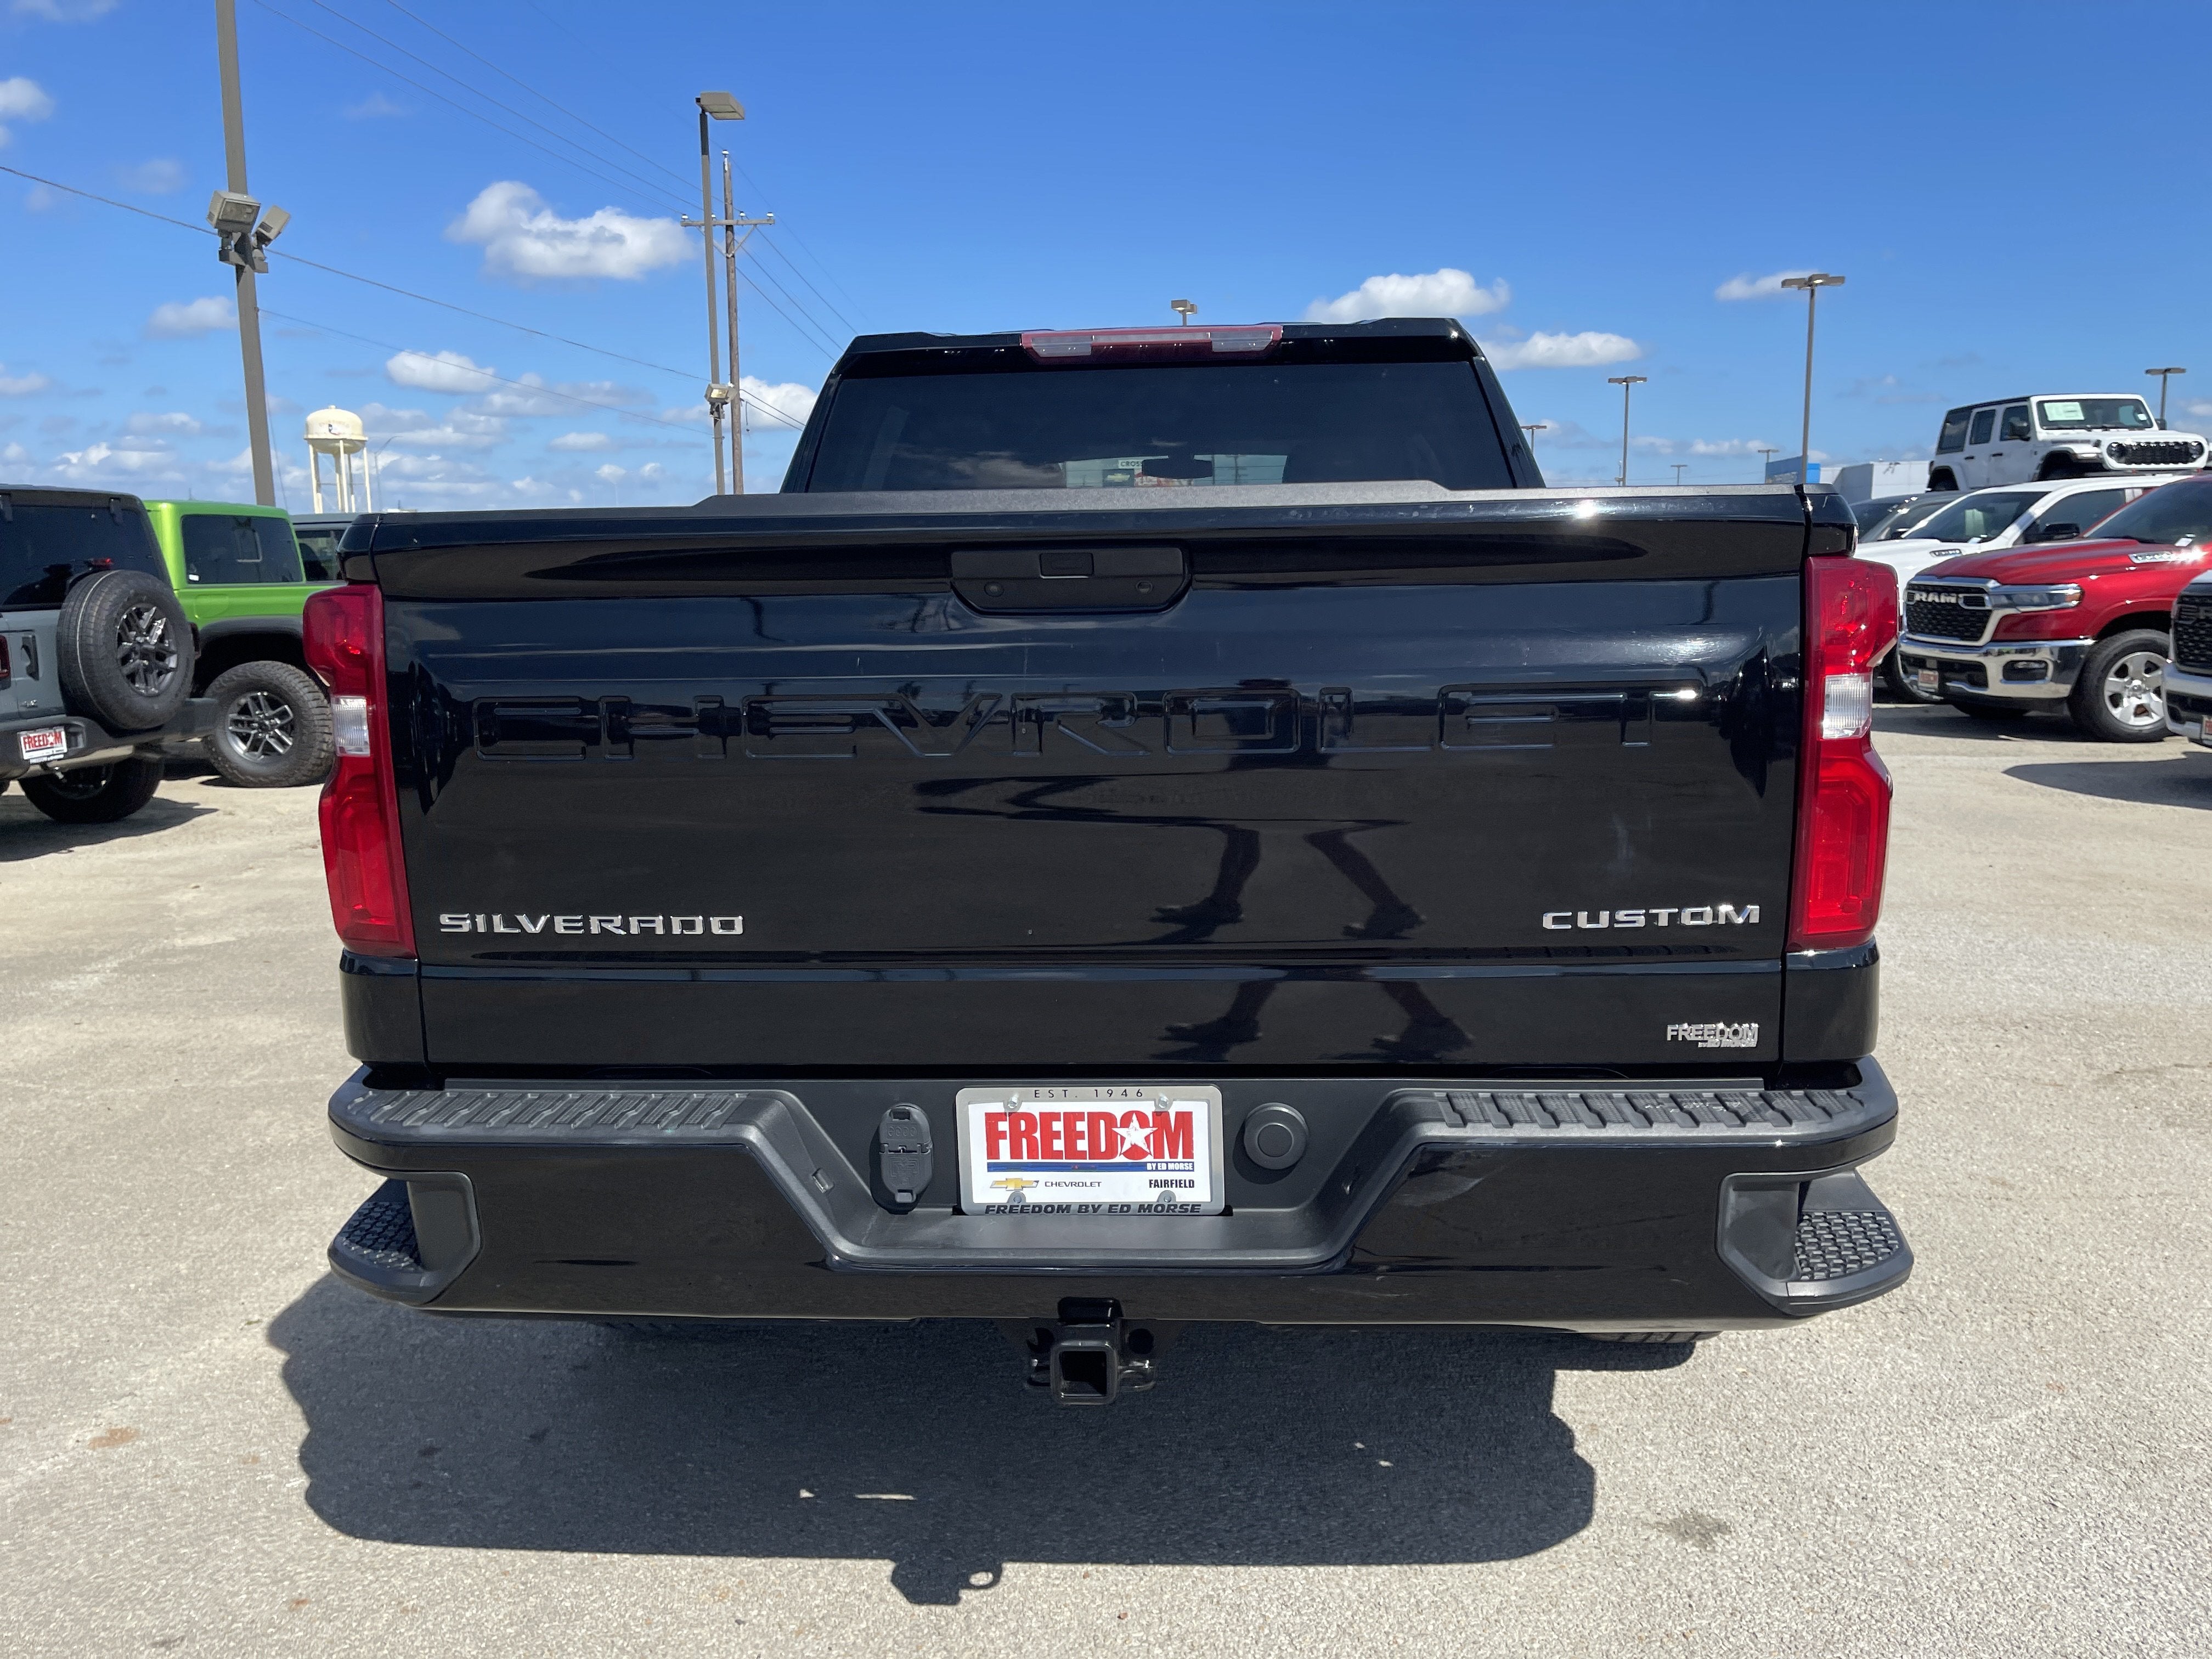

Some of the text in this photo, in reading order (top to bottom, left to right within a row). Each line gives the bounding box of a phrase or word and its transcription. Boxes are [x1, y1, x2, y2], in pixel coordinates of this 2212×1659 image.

[1915, 592, 1957, 603] RAM
[472, 680, 1706, 760] CHEVROLET
[23, 731, 63, 749] FREEDOM
[439, 913, 744, 935] SILVERADO
[1542, 903, 1760, 929] CUSTOM
[1667, 1022, 1760, 1041] FREEDOM
[1034, 1088, 1143, 1098] EST. 1946
[985, 1110, 1194, 1160] FREEDOM
[1149, 1179, 1195, 1188] FAIRFIELD
[985, 1203, 1202, 1215] FREEDOM BY ED MORSE
